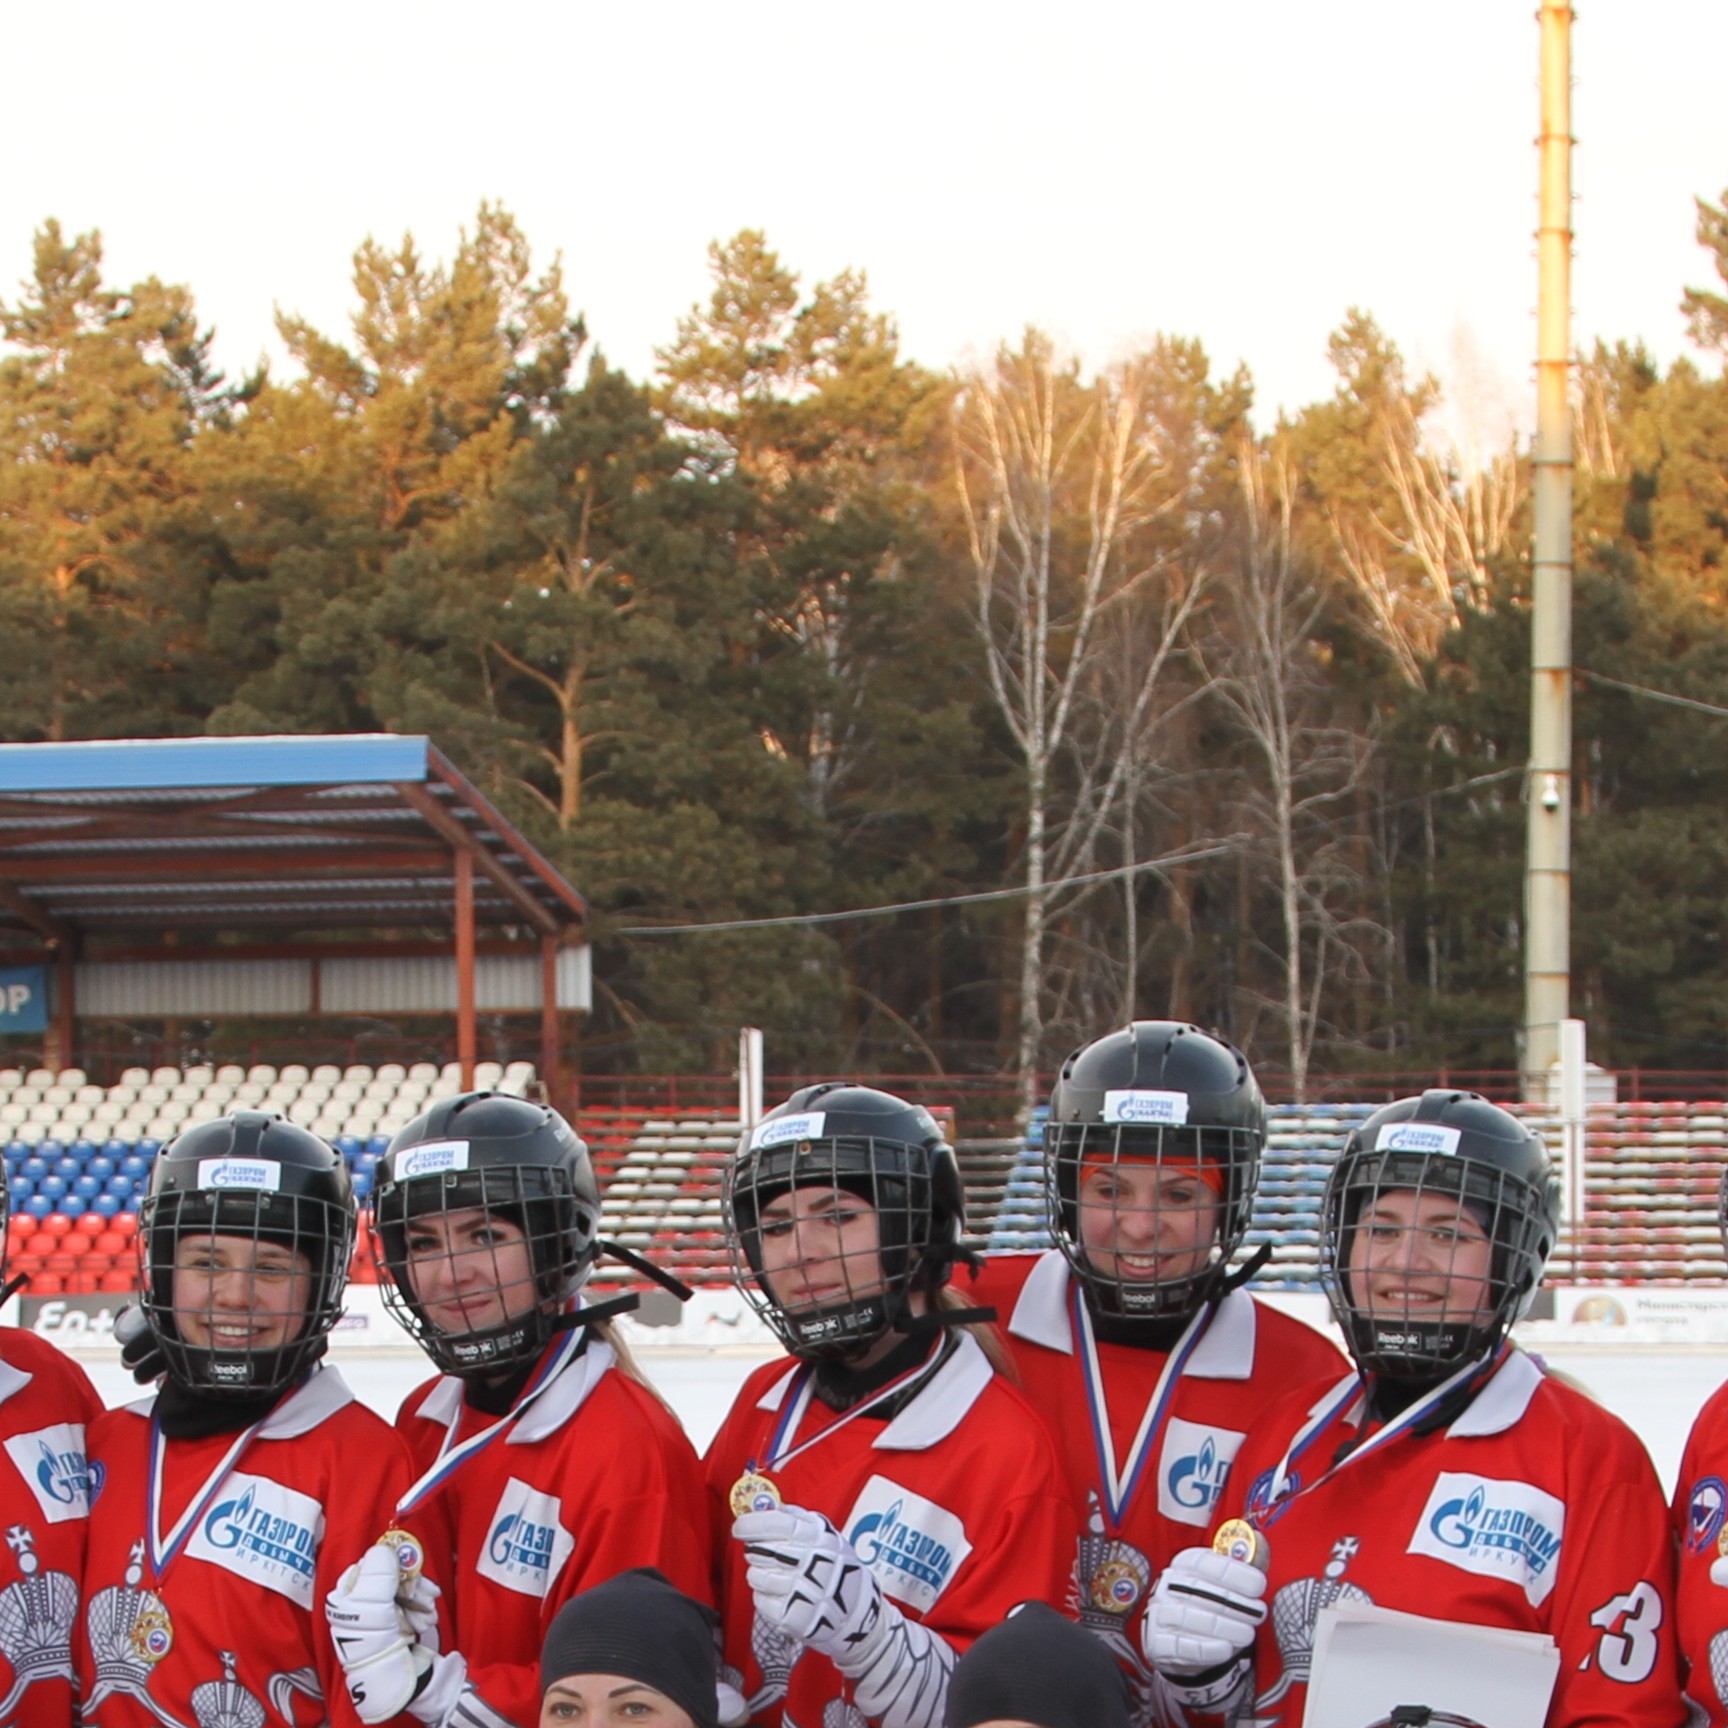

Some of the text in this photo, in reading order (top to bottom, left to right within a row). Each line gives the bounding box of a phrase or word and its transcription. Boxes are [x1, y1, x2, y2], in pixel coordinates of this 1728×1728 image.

[798, 1317, 838, 1336] Reebk
[453, 1341, 493, 1356] Reebk
[1479, 1508, 1562, 1559] ГАЗПРОМ
